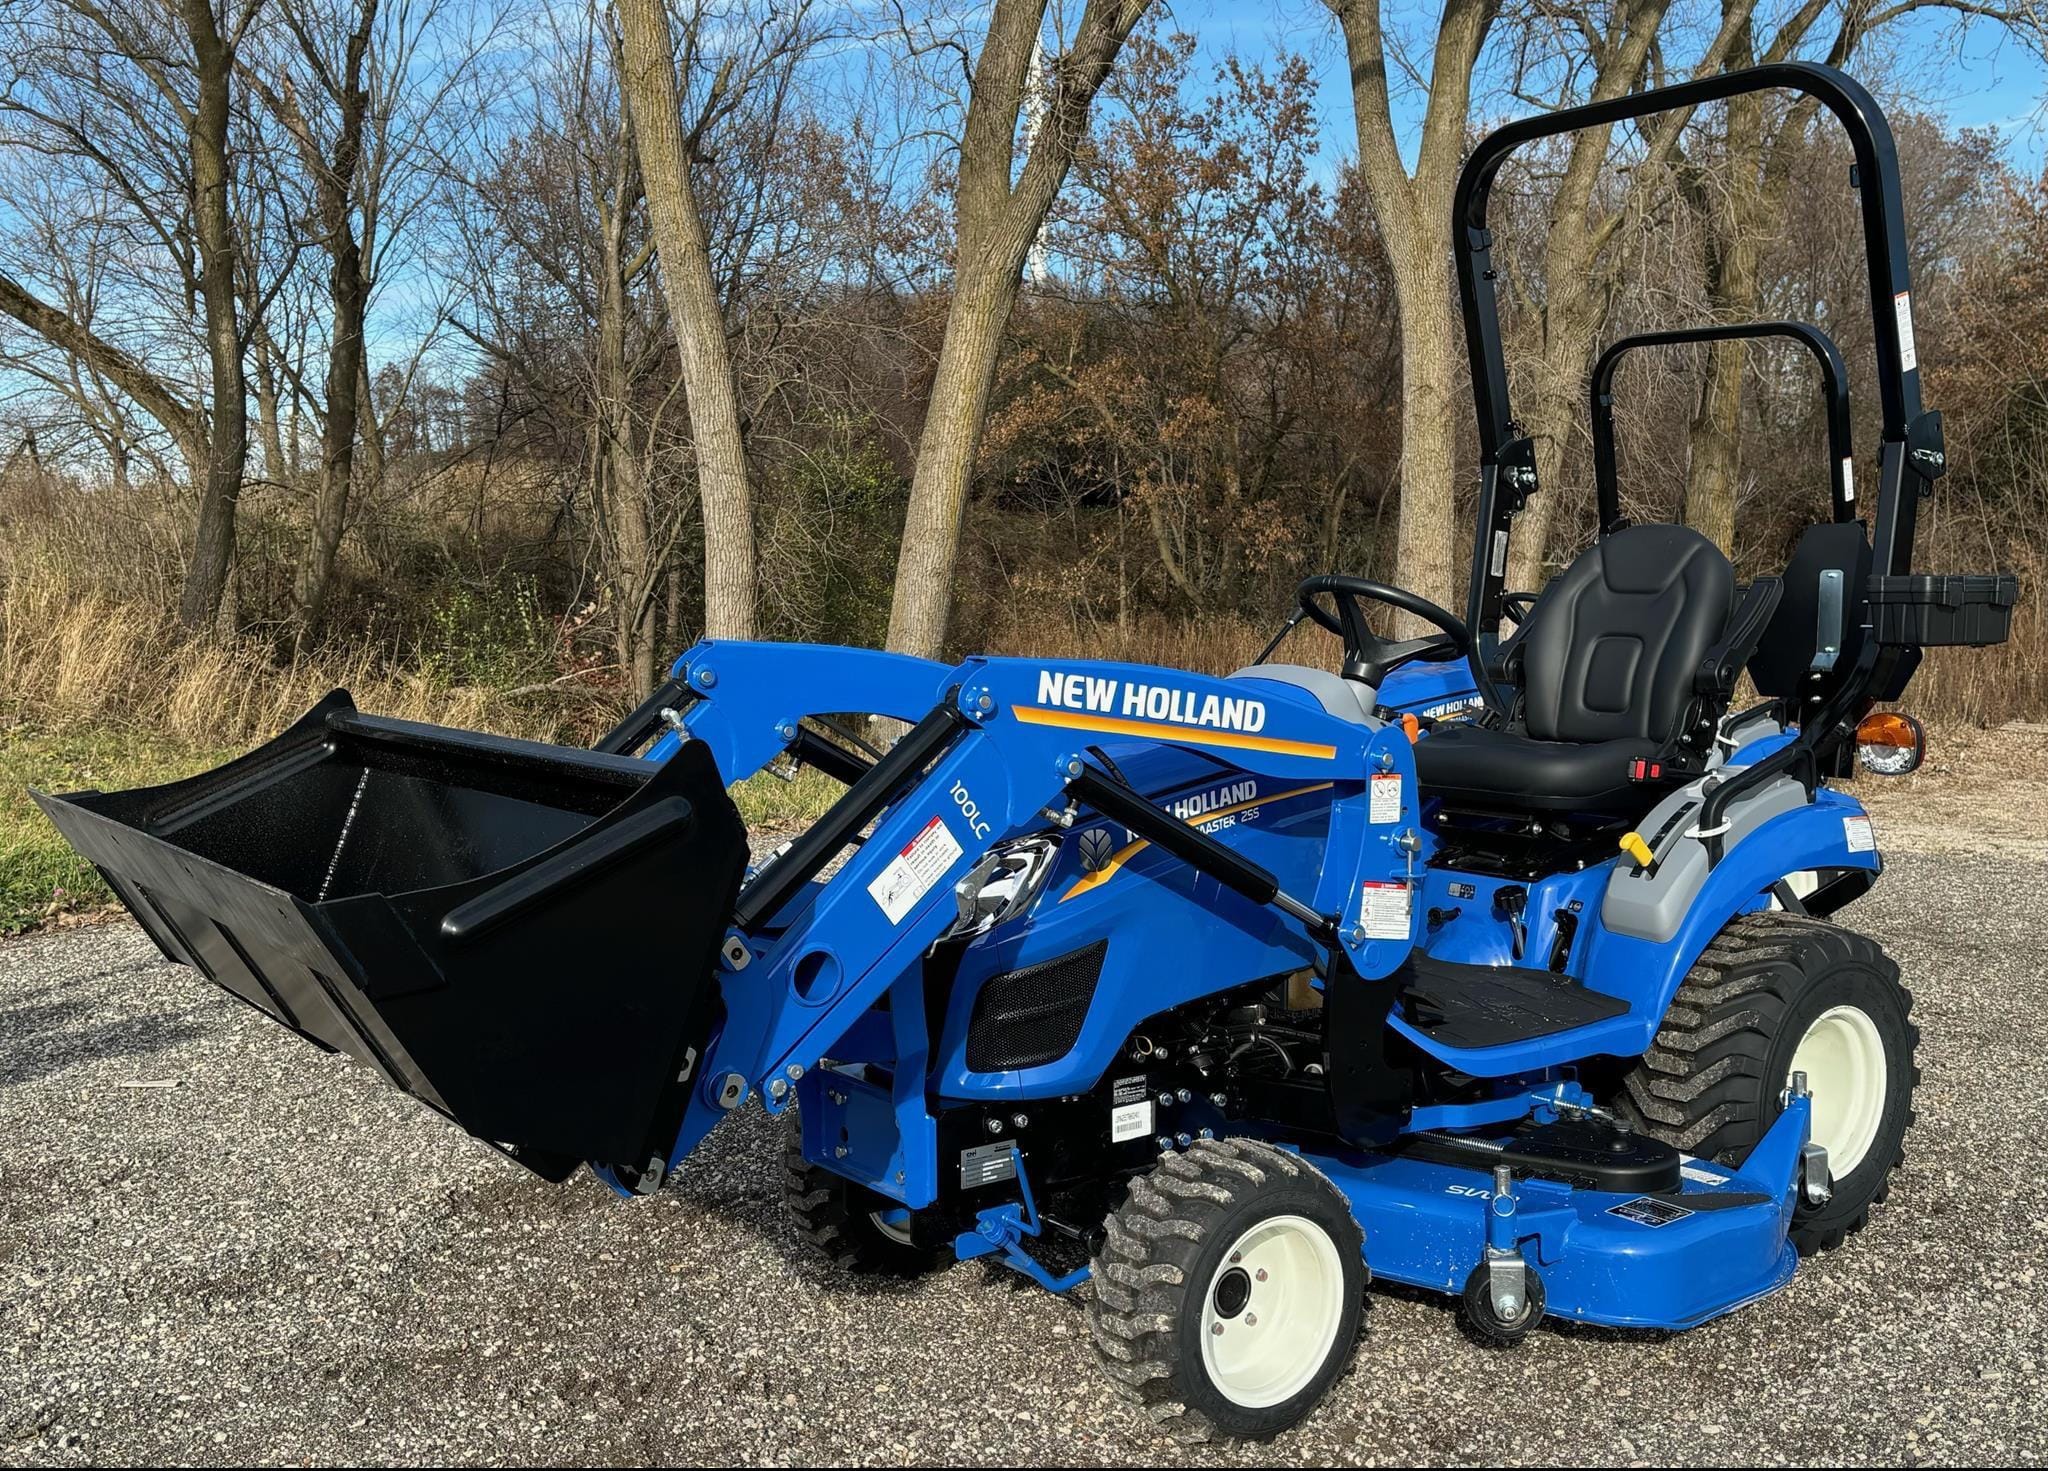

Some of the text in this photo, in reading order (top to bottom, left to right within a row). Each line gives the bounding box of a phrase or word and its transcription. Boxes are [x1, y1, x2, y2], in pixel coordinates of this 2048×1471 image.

[1037, 670, 1266, 733] NEW HOLLAND
[949, 779, 991, 840] 100LC
[1174, 780, 1257, 819] HOLLAND
